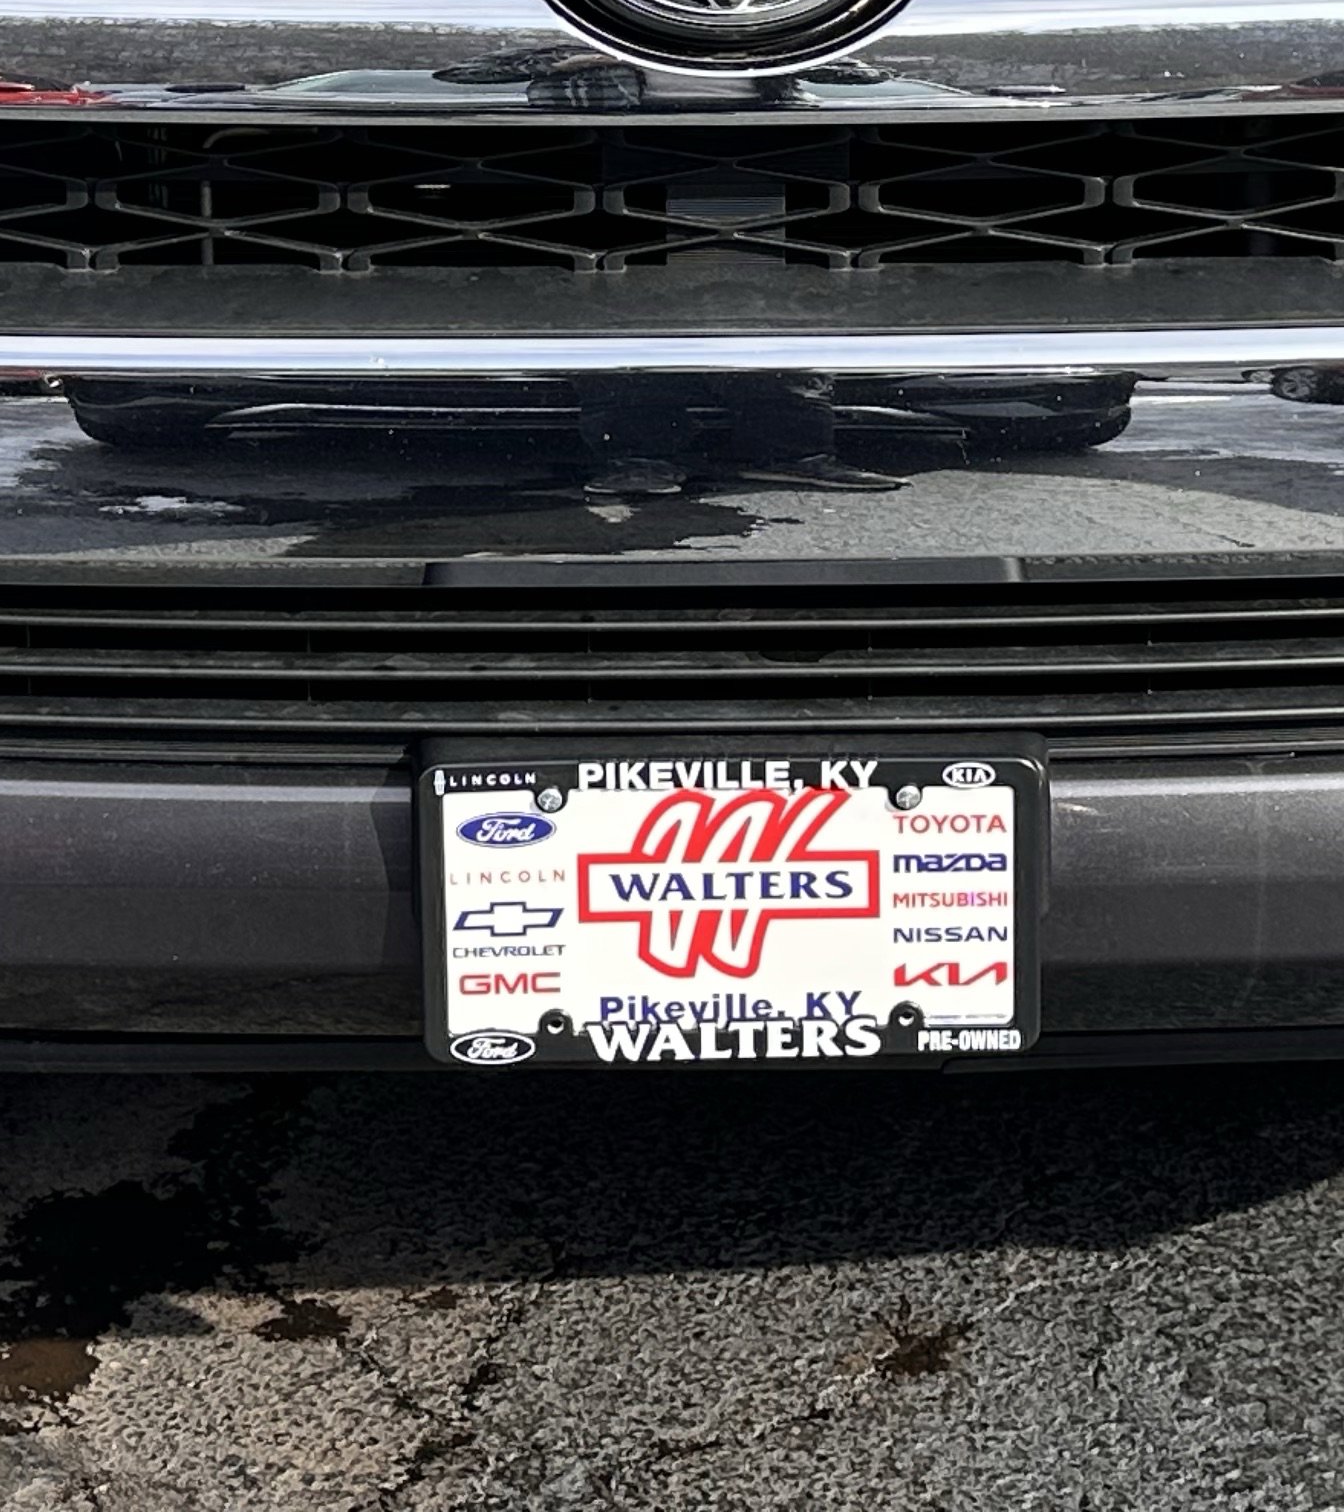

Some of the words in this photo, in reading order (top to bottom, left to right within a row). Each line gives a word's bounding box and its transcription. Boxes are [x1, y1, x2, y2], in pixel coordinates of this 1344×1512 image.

[449, 772, 536, 787] LINCOLN
[578, 761, 804, 791] PIKEVILLE,
[821, 761, 878, 790] KY
[951, 768, 987, 784] KIA
[476, 818, 536, 842] Ford
[893, 814, 1007, 834] TOYOTA
[449, 869, 565, 885] LINCOLN
[609, 870, 853, 902] WALTERS
[893, 892, 1008, 908] MITSUBISHI
[893, 926, 1008, 944] NISSAN
[453, 944, 566, 958] CHEVROLET
[459, 972, 561, 995] GMC
[894, 962, 1008, 987] KIA
[806, 991, 862, 1019] KY
[467, 1037, 518, 1059] Ford
[586, 1019, 882, 1062] WALTERS
[917, 1030, 1022, 1052] PRE-OWNED
